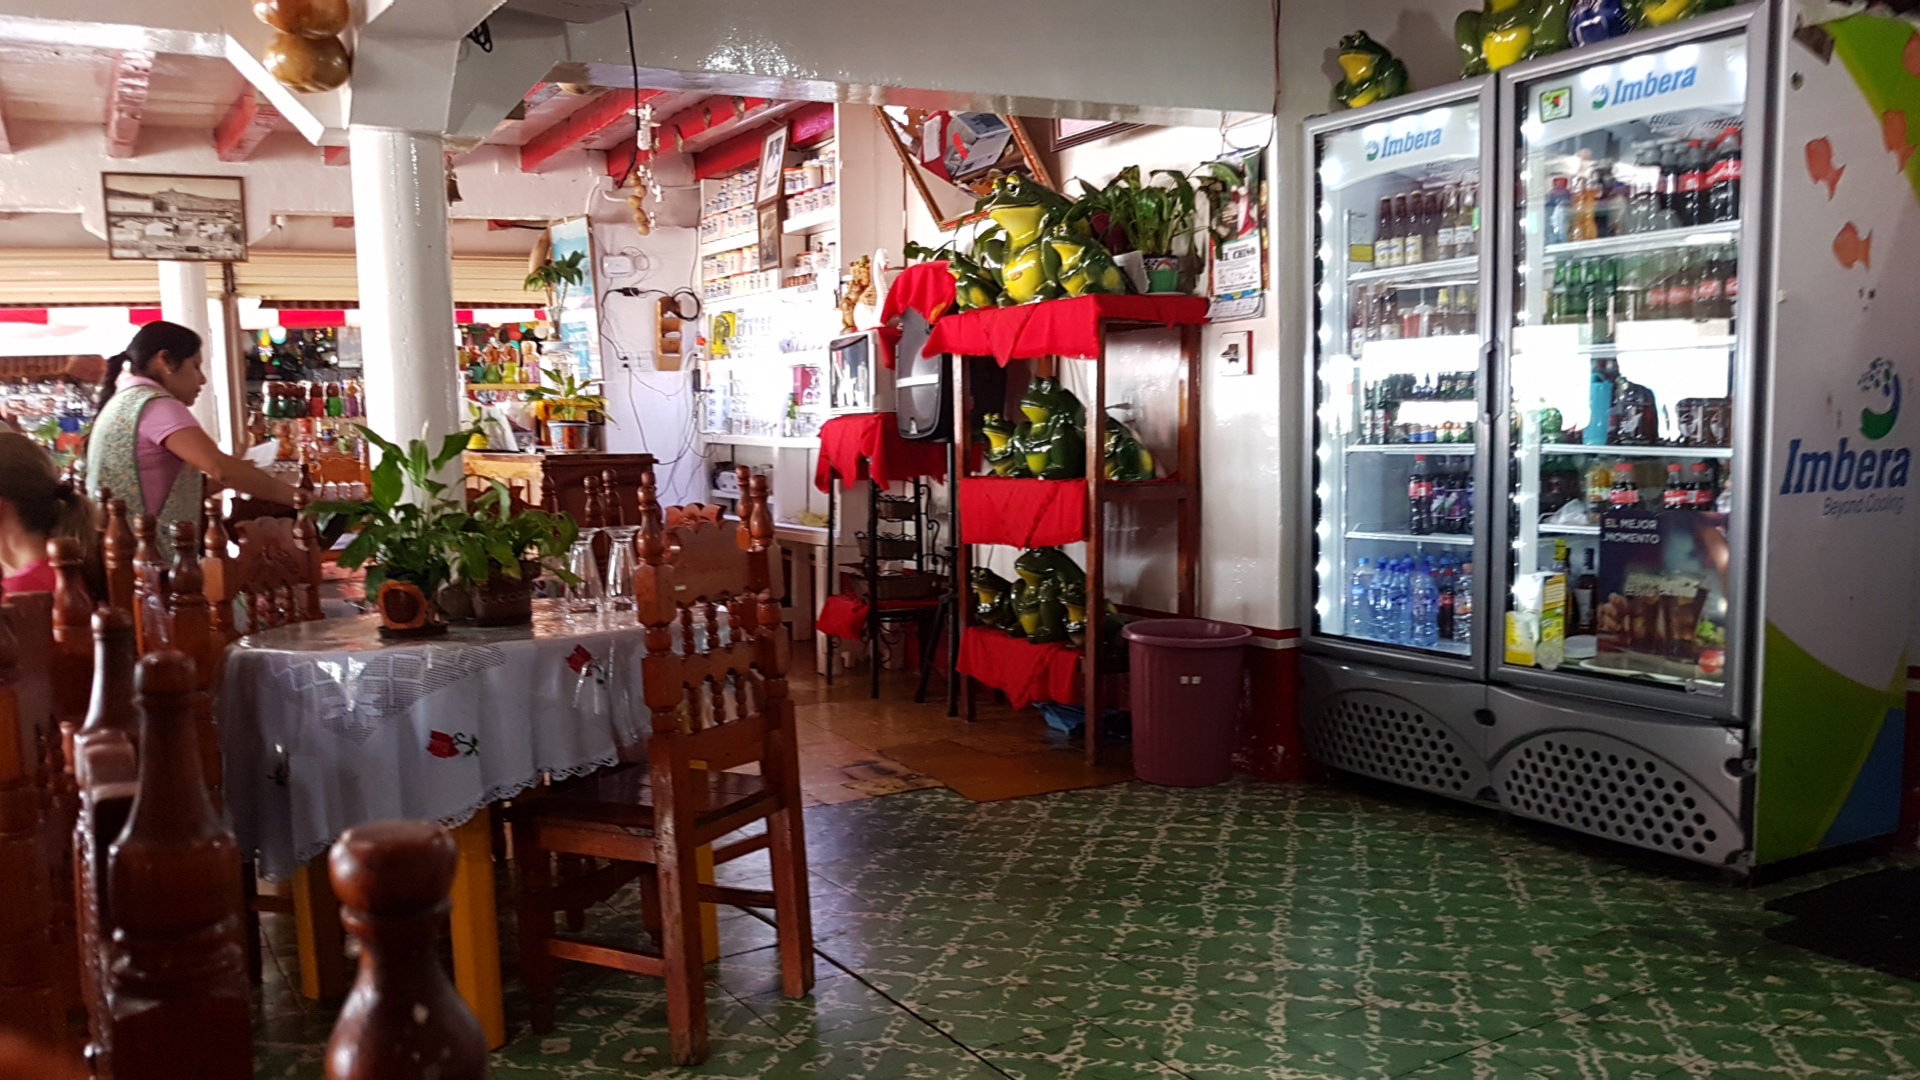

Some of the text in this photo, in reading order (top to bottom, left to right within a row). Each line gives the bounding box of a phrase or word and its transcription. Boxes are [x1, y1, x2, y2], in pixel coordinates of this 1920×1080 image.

[1611, 66, 1697, 106] Imbera
[1381, 128, 1442, 158] Imbera
[1779, 437, 1912, 495] Imbera
[1823, 493, 1904, 519] Beyond Cooling
[1603, 532, 1660, 544] MOMENTO
[1605, 518, 1658, 530] EL MEJOR
